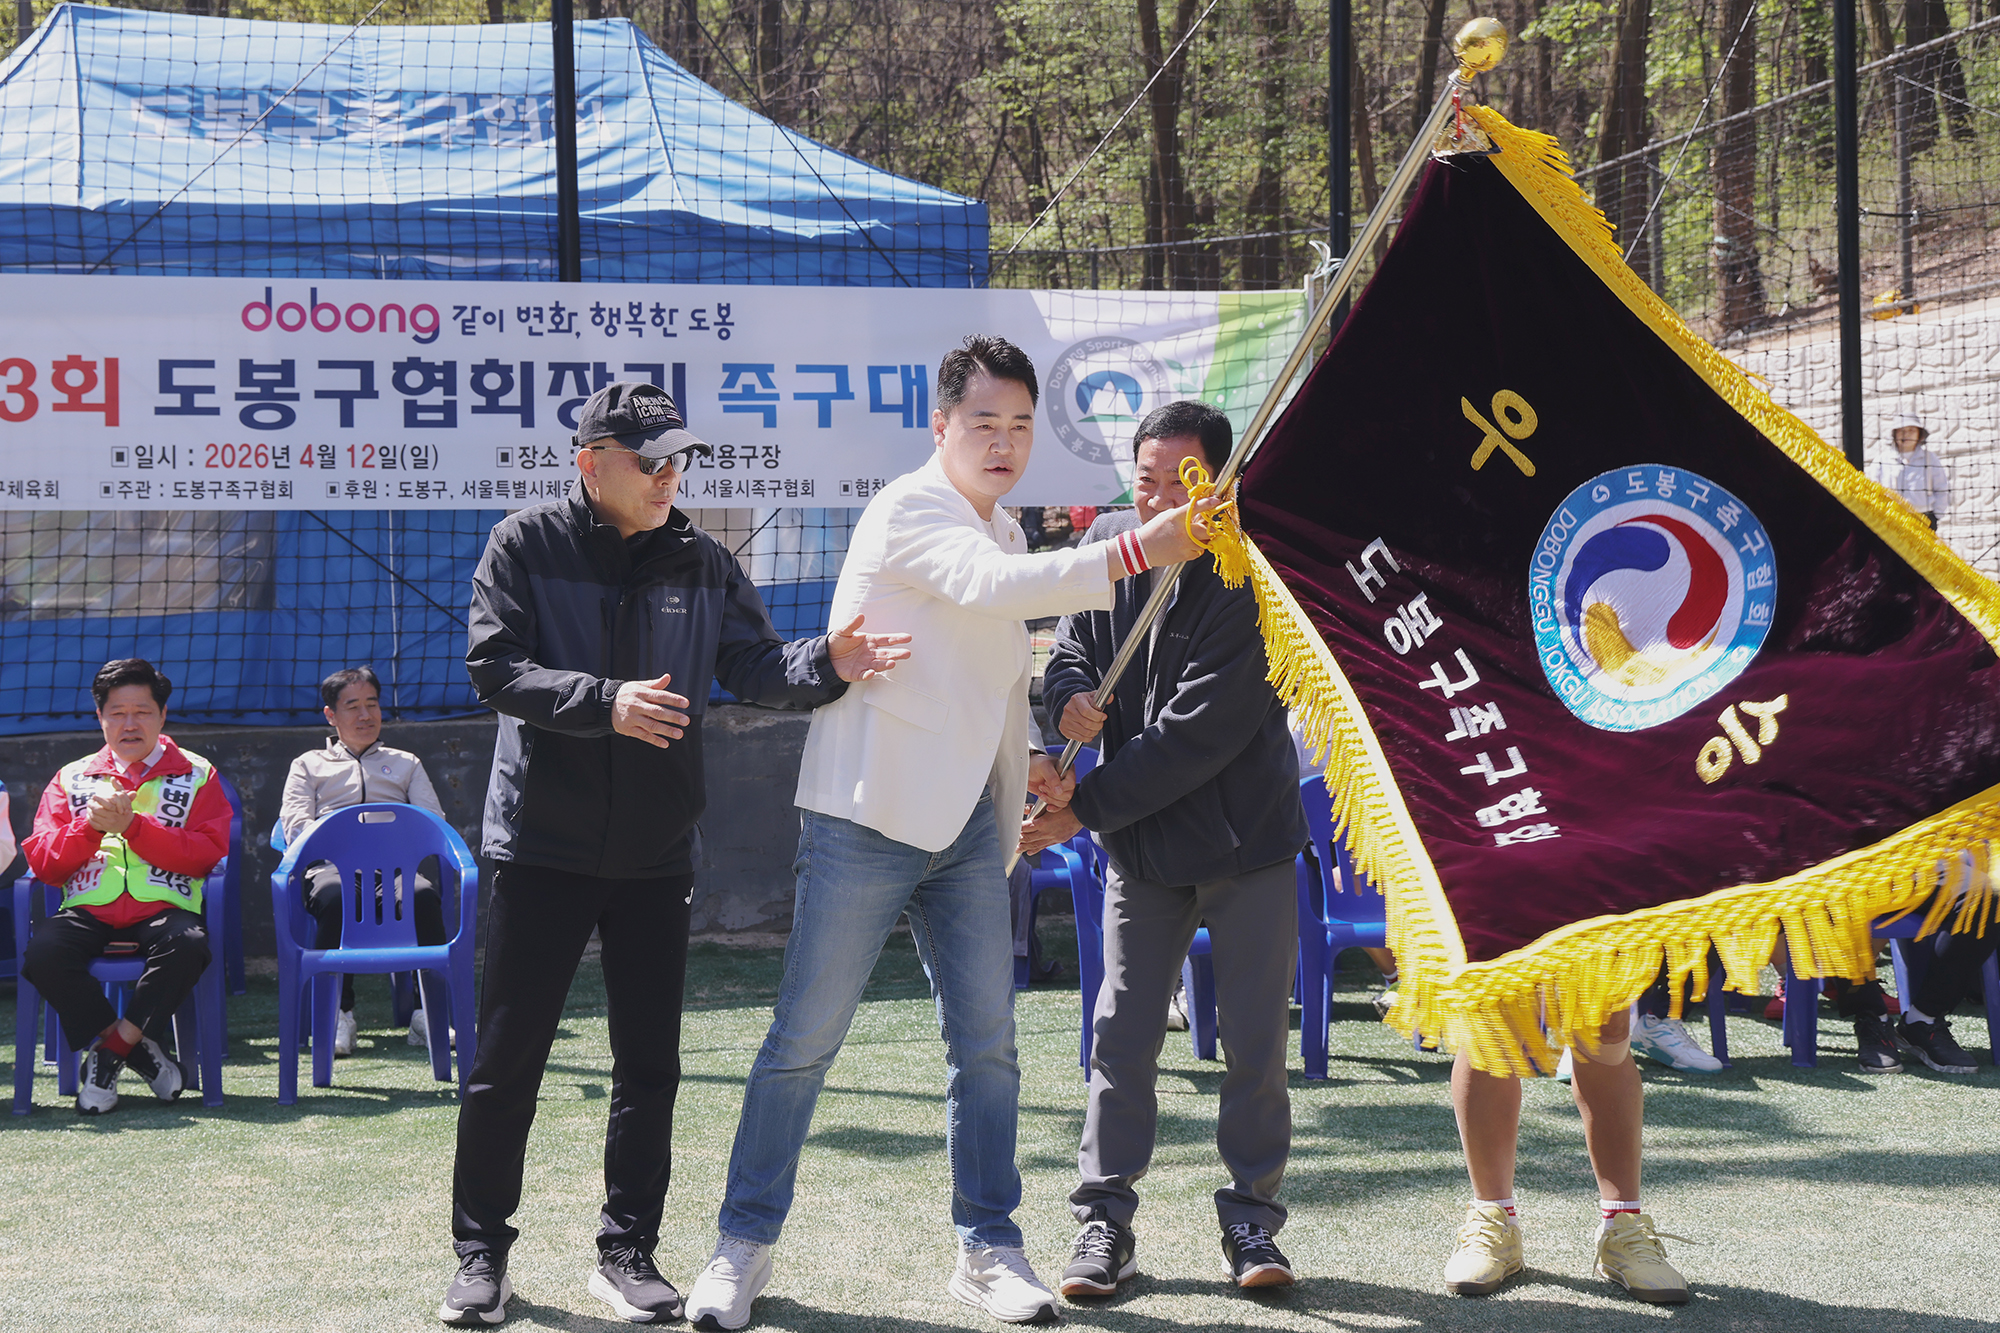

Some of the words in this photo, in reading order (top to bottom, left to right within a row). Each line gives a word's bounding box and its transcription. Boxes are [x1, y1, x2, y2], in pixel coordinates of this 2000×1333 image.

[241, 286, 440, 345] dobong
[452, 305, 504, 336] 같이
[516, 300, 581, 339] 변화,
[590, 301, 679, 338] 행복한
[688, 302, 735, 341] 도봉
[1050, 347, 1085, 389] Dobong
[1086, 340, 1129, 352] Sports
[1132, 346, 1167, 389] Council
[0, 354, 120, 427] 3회
[154, 356, 688, 431] 도봉구협회장기
[717, 362, 929, 429] 족구대
[636, 405, 665, 419] ICON
[134, 444, 176, 470] 일시
[204, 443, 291, 470] 2026년
[299, 443, 336, 470] 4월
[346, 443, 439, 471] 12일(일)
[518, 445, 560, 470] 장소
[117, 480, 152, 500] 주관
[172, 480, 293, 500] 도봉구족구협회
[344, 479, 377, 500] 후원
[397, 480, 454, 501] 도봉구,
[702, 478, 815, 499] 서울시족구협회
[1532, 507, 1578, 634] DOBONGGU
[1540, 641, 1592, 706] JOKGU
[1582, 671, 1721, 726] ASSOCIATION
